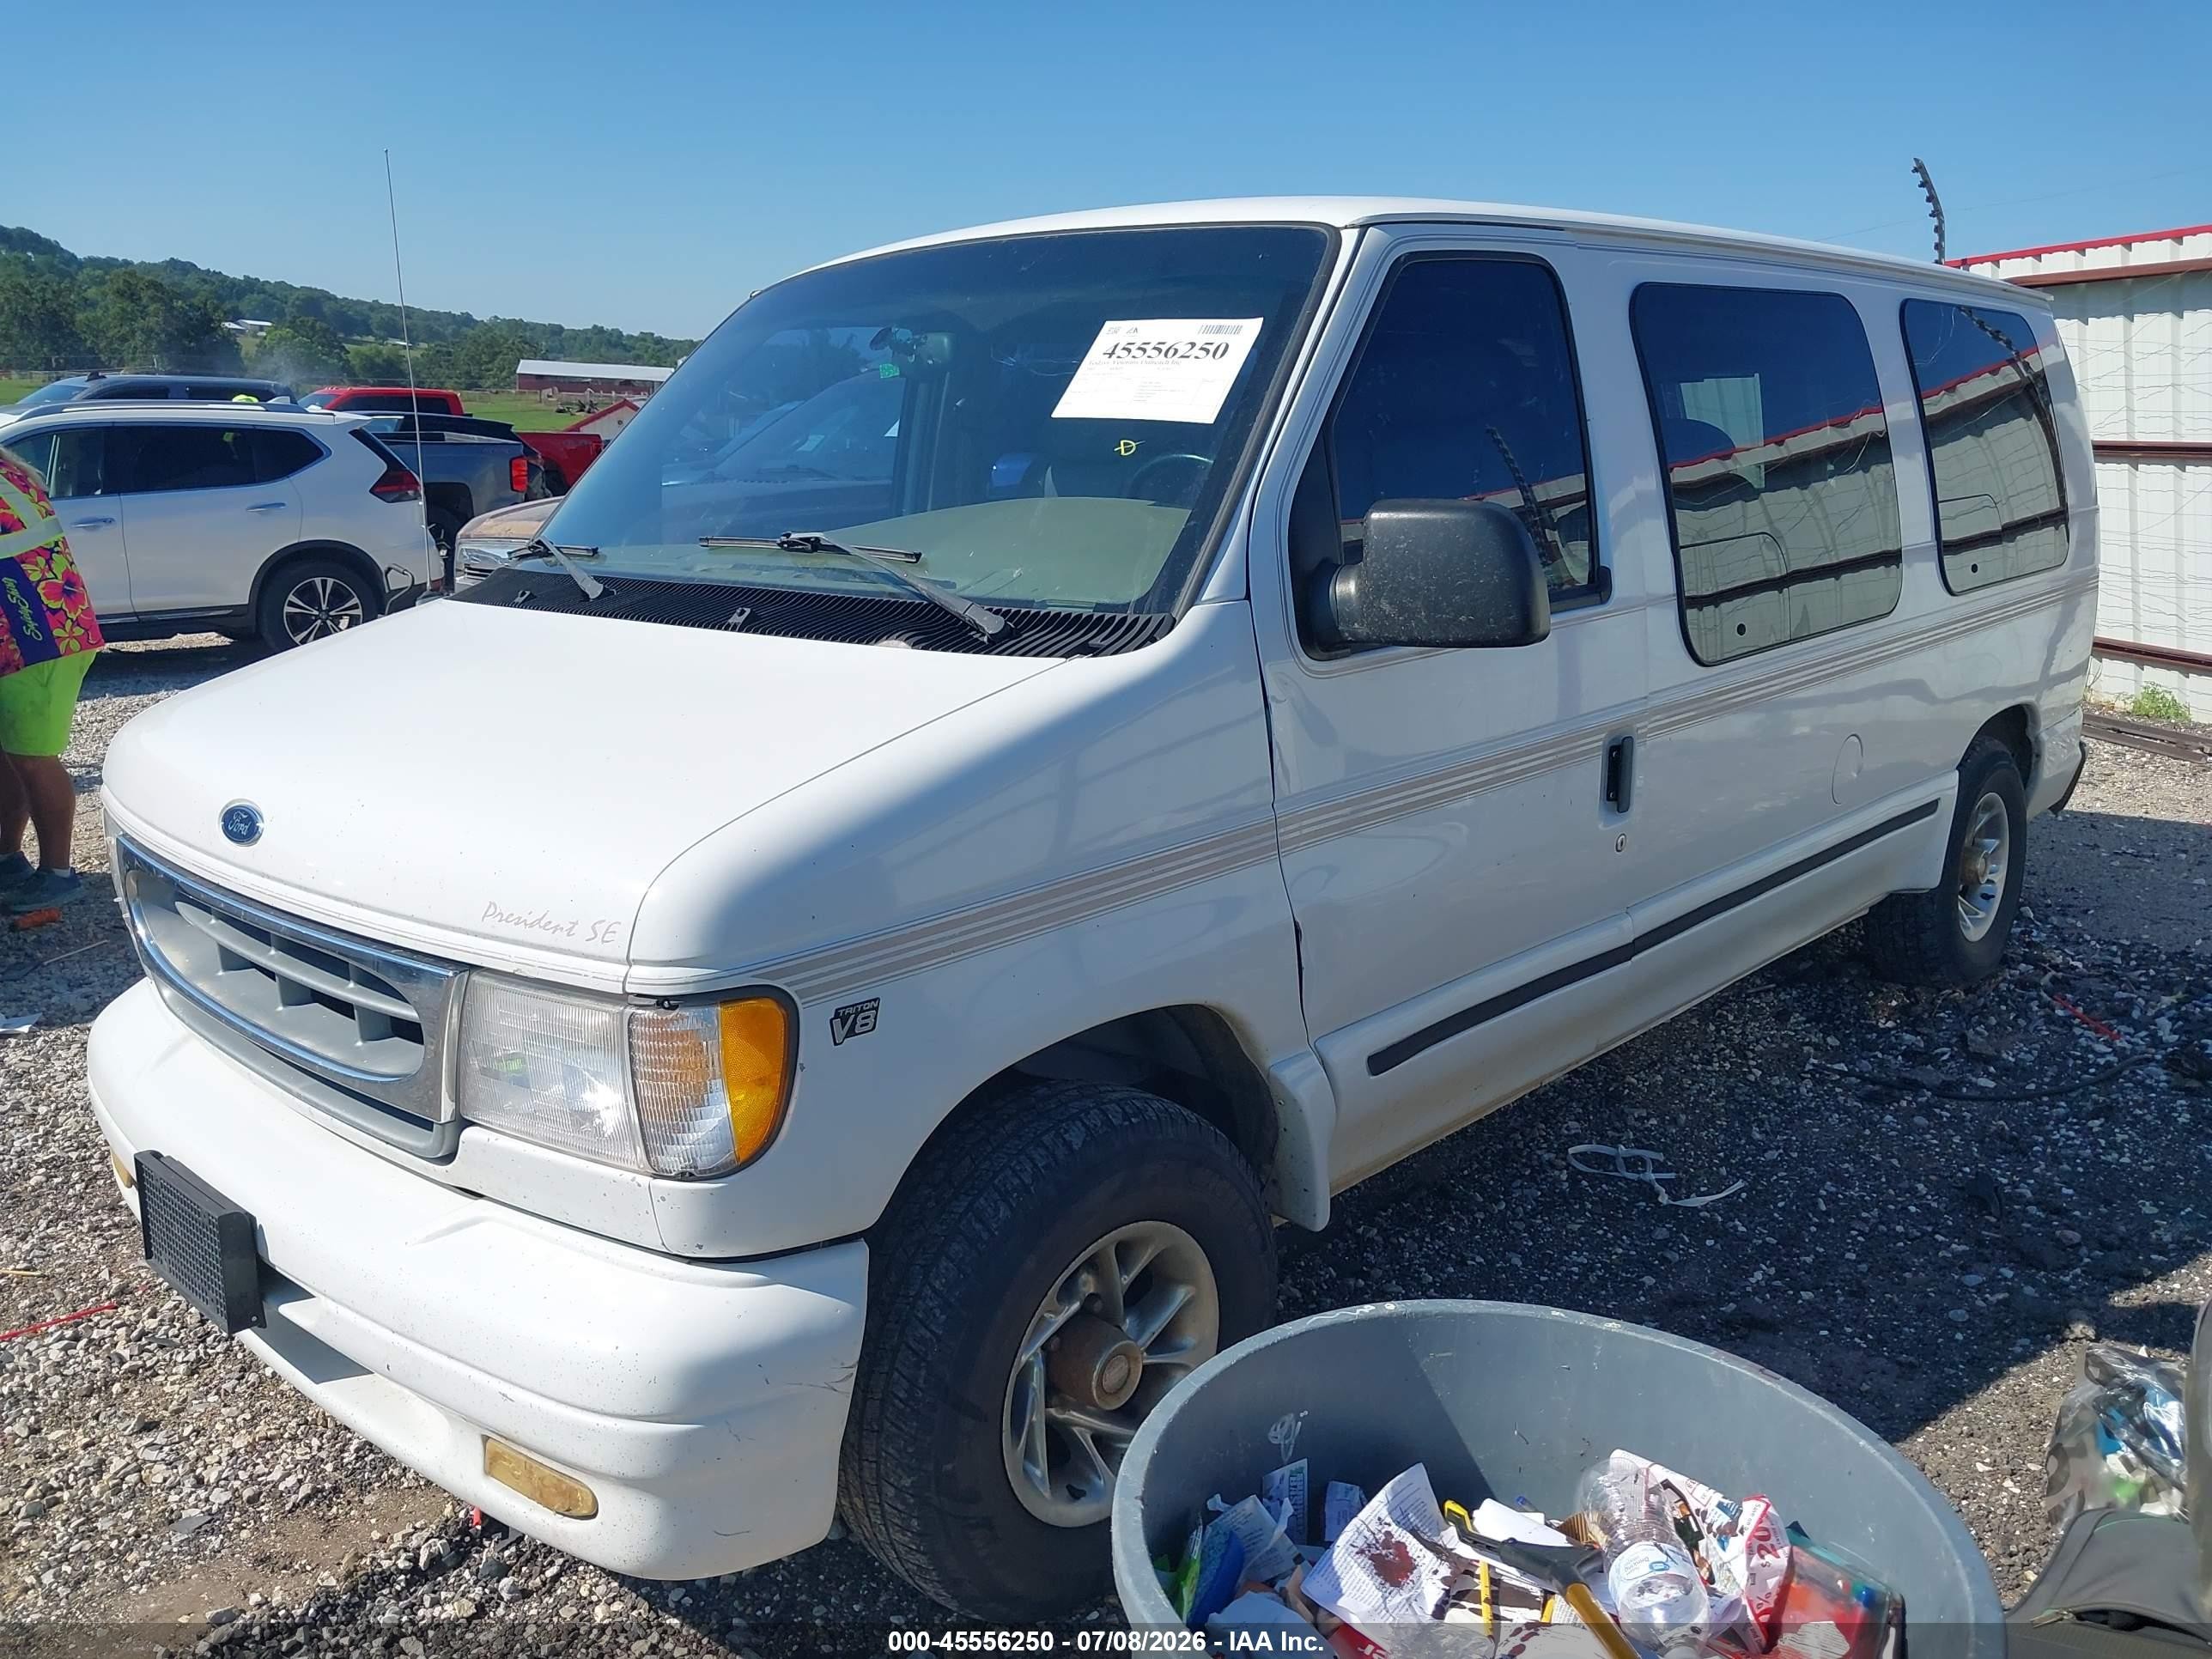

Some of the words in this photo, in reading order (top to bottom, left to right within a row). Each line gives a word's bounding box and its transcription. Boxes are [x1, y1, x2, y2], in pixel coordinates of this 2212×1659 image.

[1103, 341, 1230, 360] 45556250
[228, 811, 252, 836] Ford
[481, 900, 580, 938] President
[585, 920, 622, 945] SE
[837, 1000, 879, 1017] TRITON
[832, 1009, 877, 1044] V8
